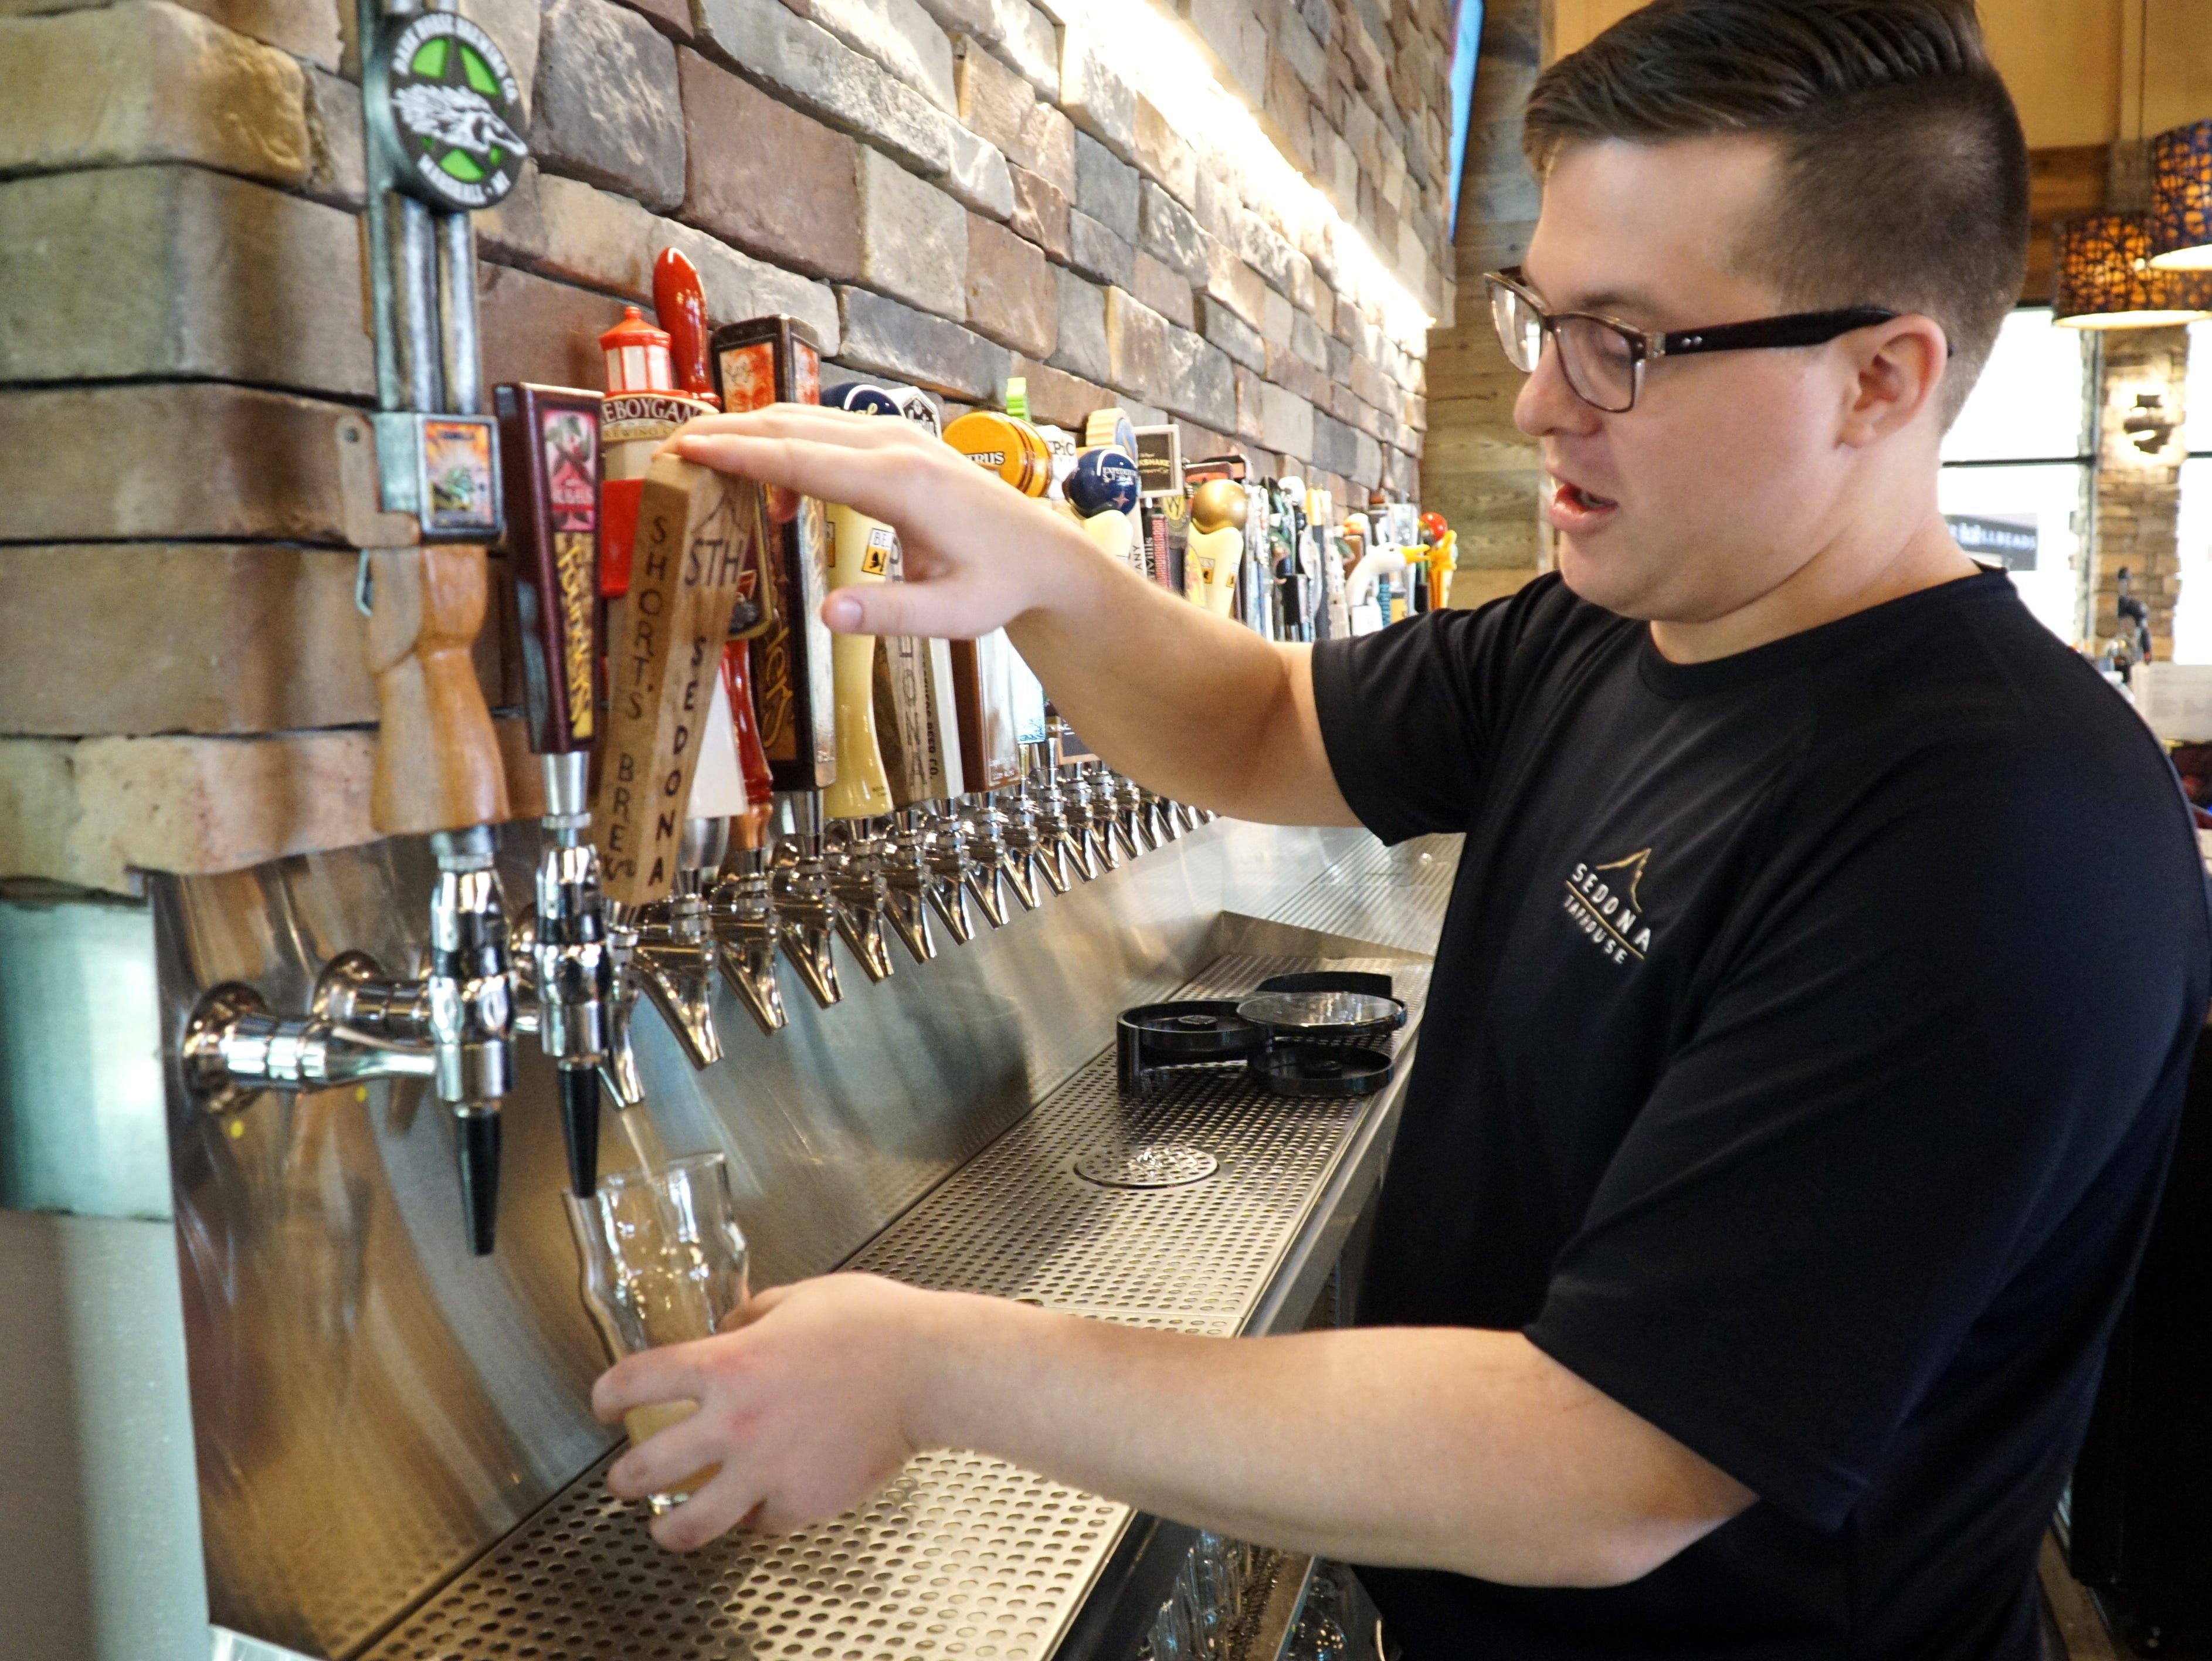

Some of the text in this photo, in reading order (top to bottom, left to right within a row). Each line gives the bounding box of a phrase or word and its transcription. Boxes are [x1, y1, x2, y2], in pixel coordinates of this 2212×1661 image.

[601, 397, 701, 425] EBOYGAN
[647, 636, 707, 887] SEDONA
[1562, 893, 1629, 965] TAPHOUSE
[1571, 862, 1651, 952] SEDONA
